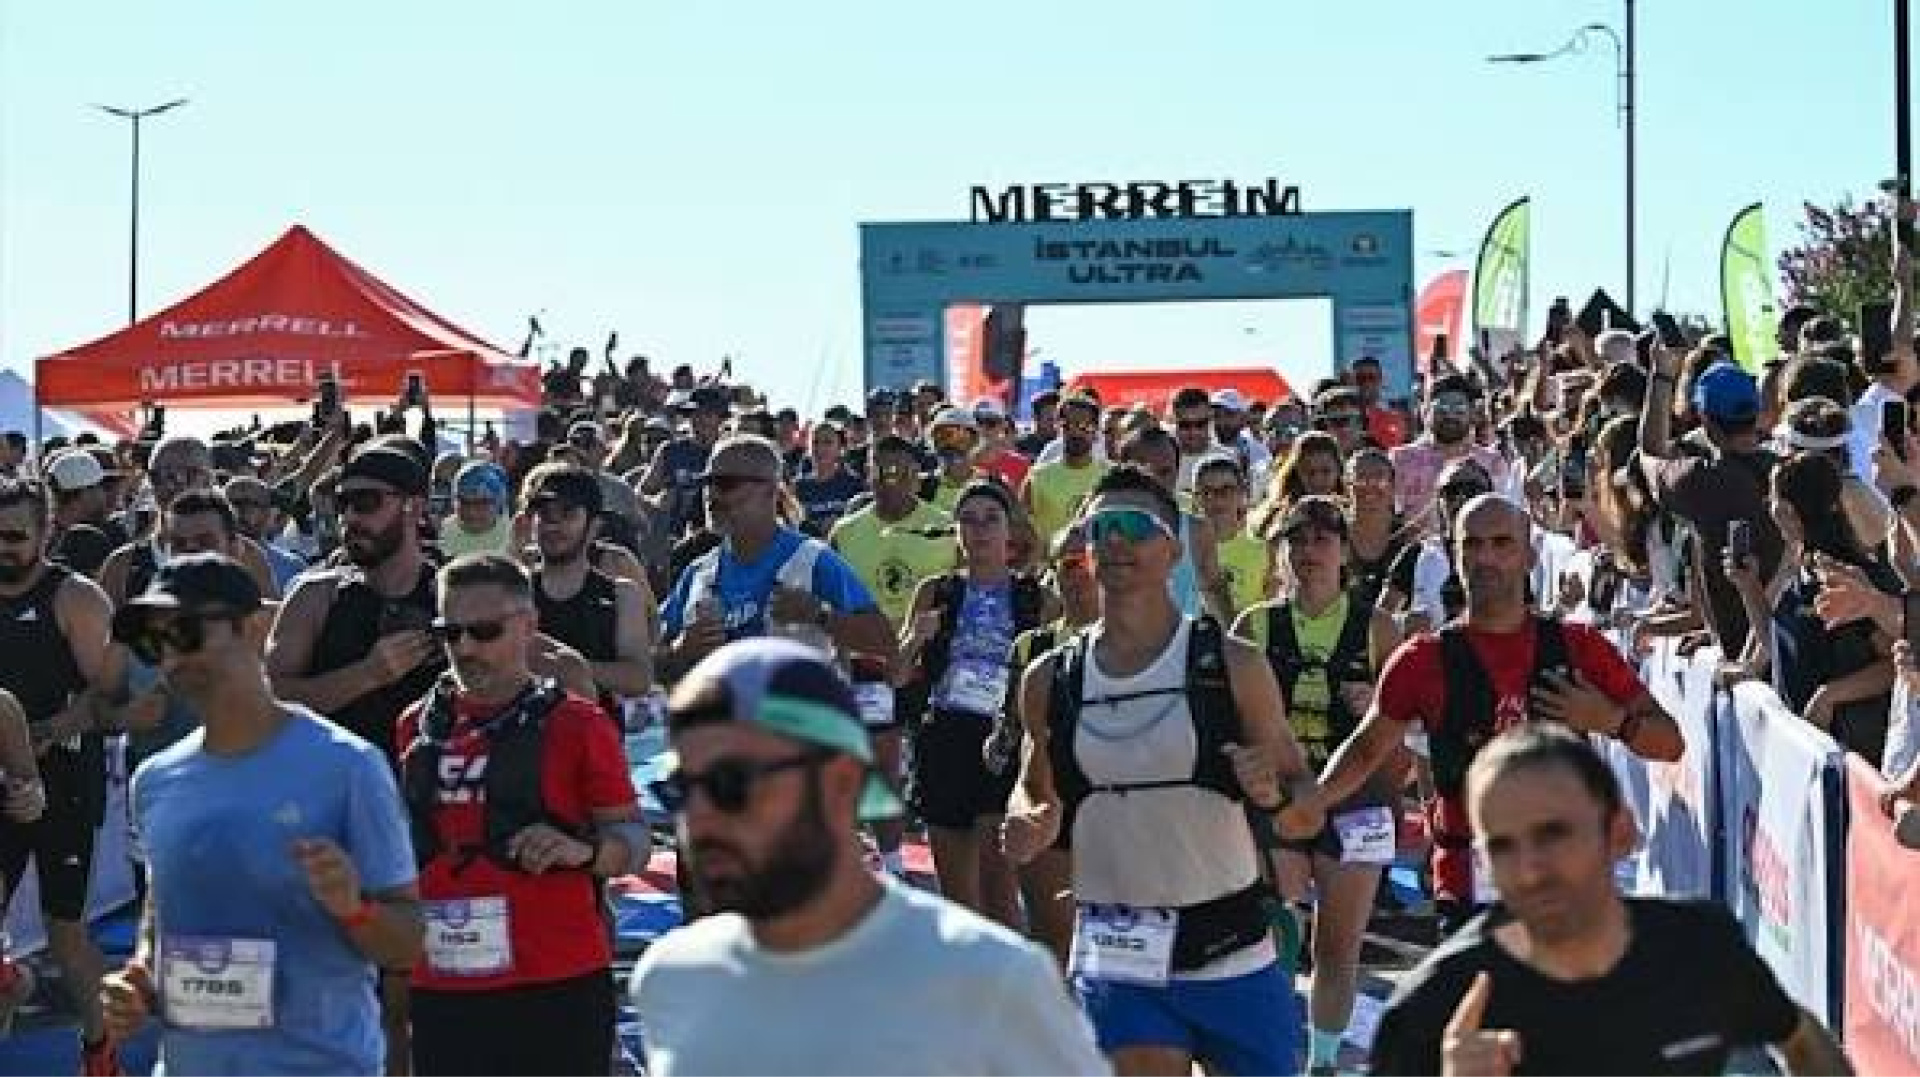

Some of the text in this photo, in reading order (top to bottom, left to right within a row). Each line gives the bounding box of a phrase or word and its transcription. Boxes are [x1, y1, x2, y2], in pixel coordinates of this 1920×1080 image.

[1068, 262, 1203, 283] ULTRA
[160, 314, 366, 337] MERRELL
[140, 359, 355, 391] MERRELL
